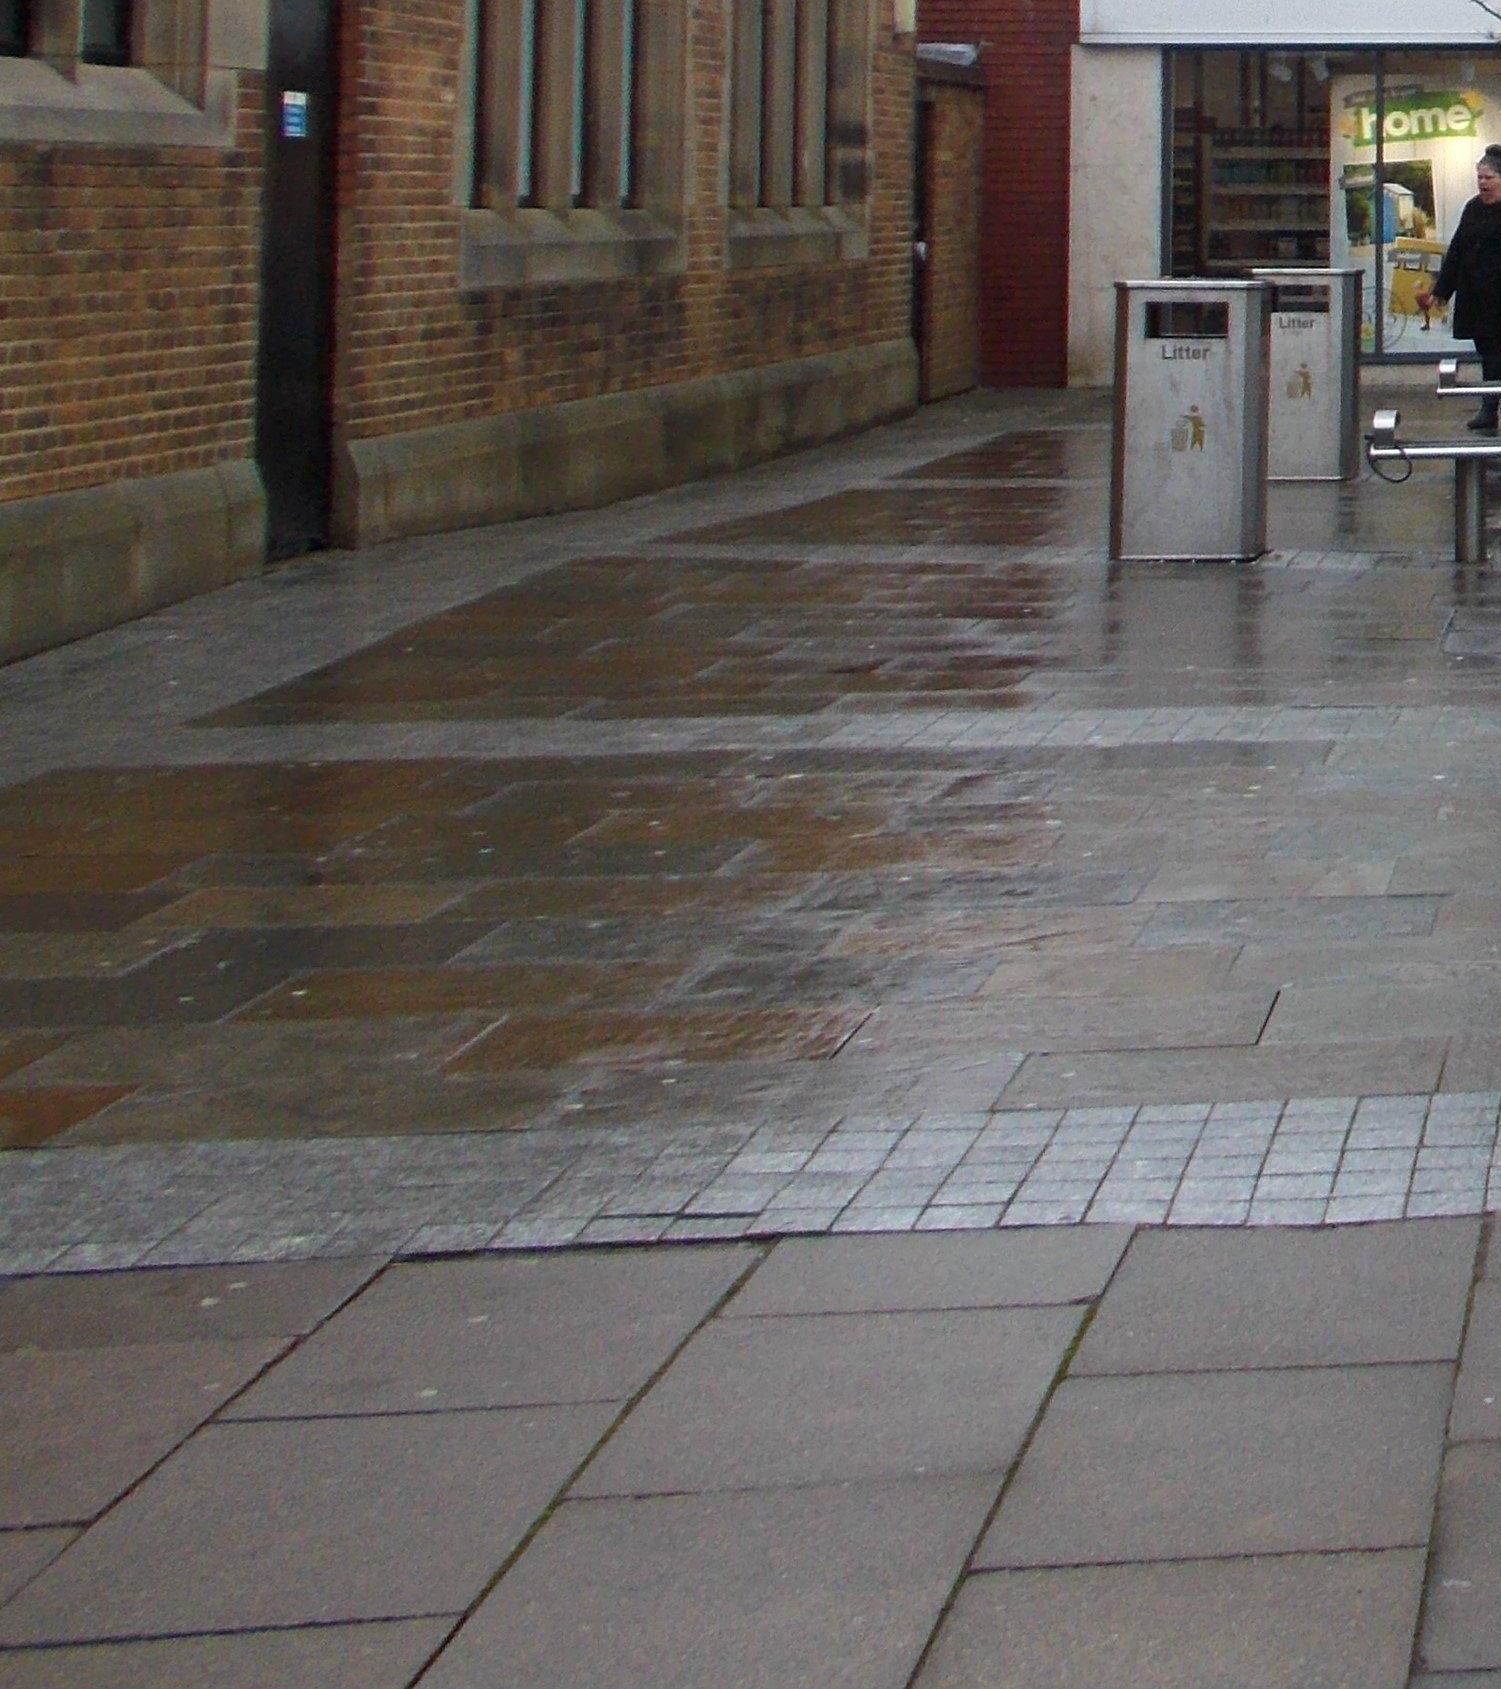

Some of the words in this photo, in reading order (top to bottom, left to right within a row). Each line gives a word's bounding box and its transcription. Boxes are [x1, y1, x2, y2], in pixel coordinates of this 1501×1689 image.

[1359, 102, 1473, 139] home
[1278, 316, 1316, 330] Litter
[1161, 344, 1211, 361] Litter
